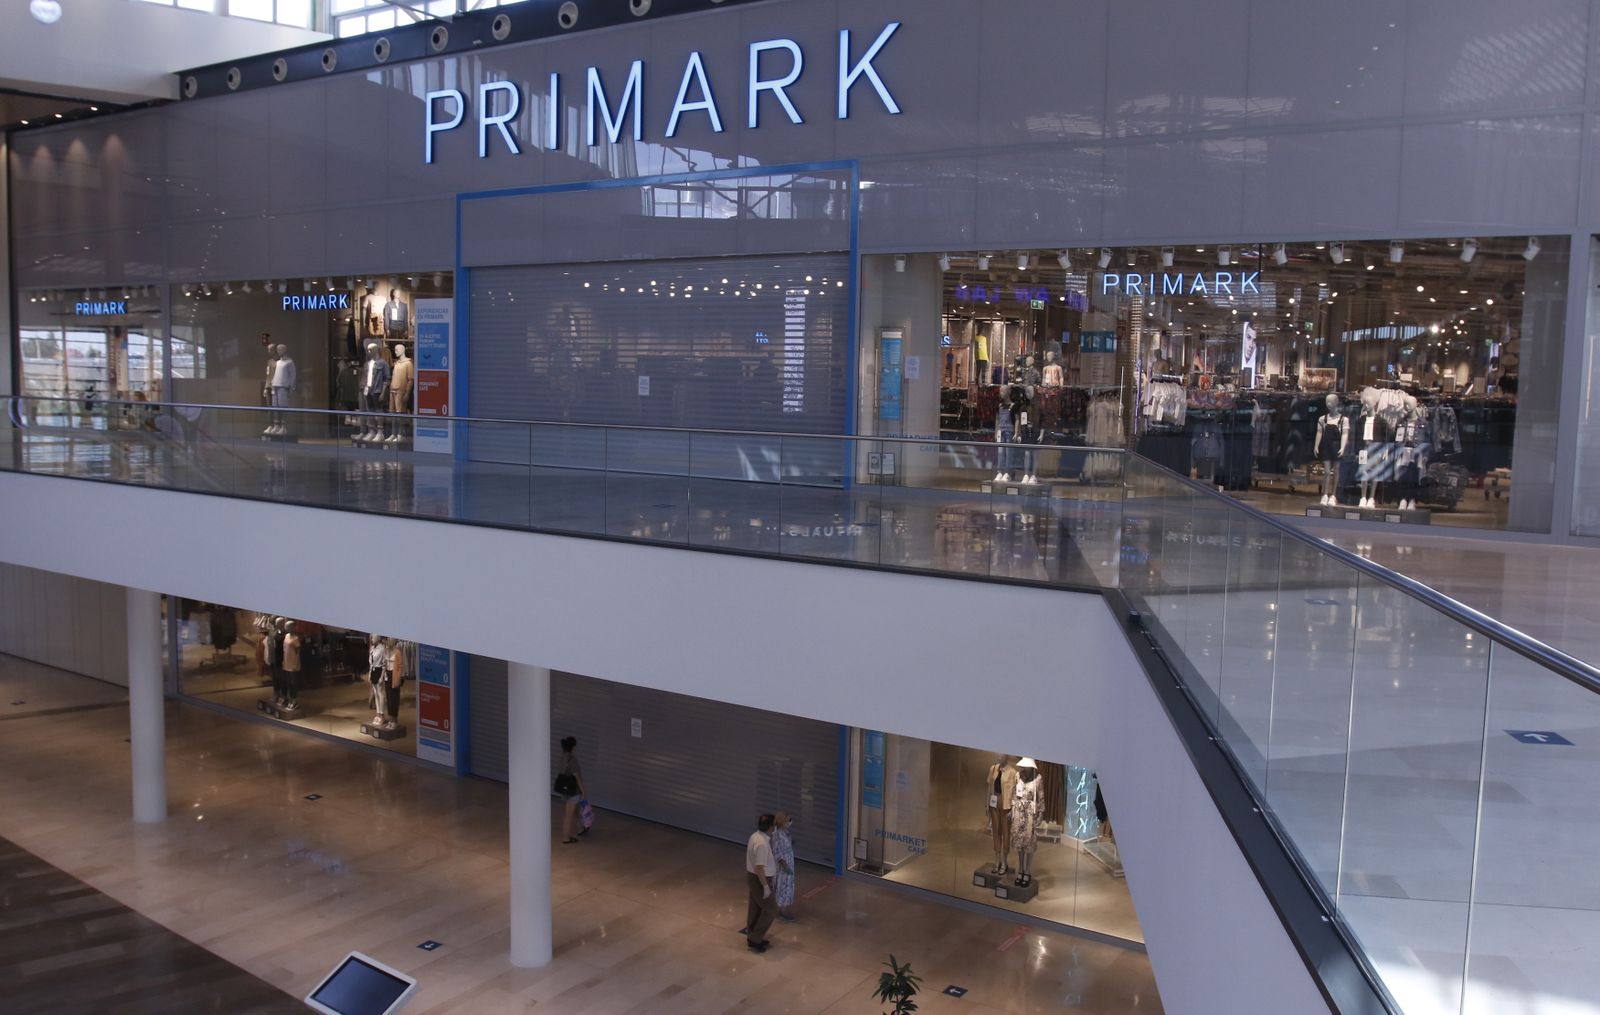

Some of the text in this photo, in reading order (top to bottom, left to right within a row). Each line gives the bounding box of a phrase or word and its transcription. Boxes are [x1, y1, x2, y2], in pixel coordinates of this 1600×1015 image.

[425, 22, 903, 164] PRIMARK
[1103, 272, 1260, 295] PRIMARK
[75, 301, 126, 316] PRIMARK
[282, 294, 349, 312] PRIMARK
[874, 829, 926, 847] PRIMARKET
